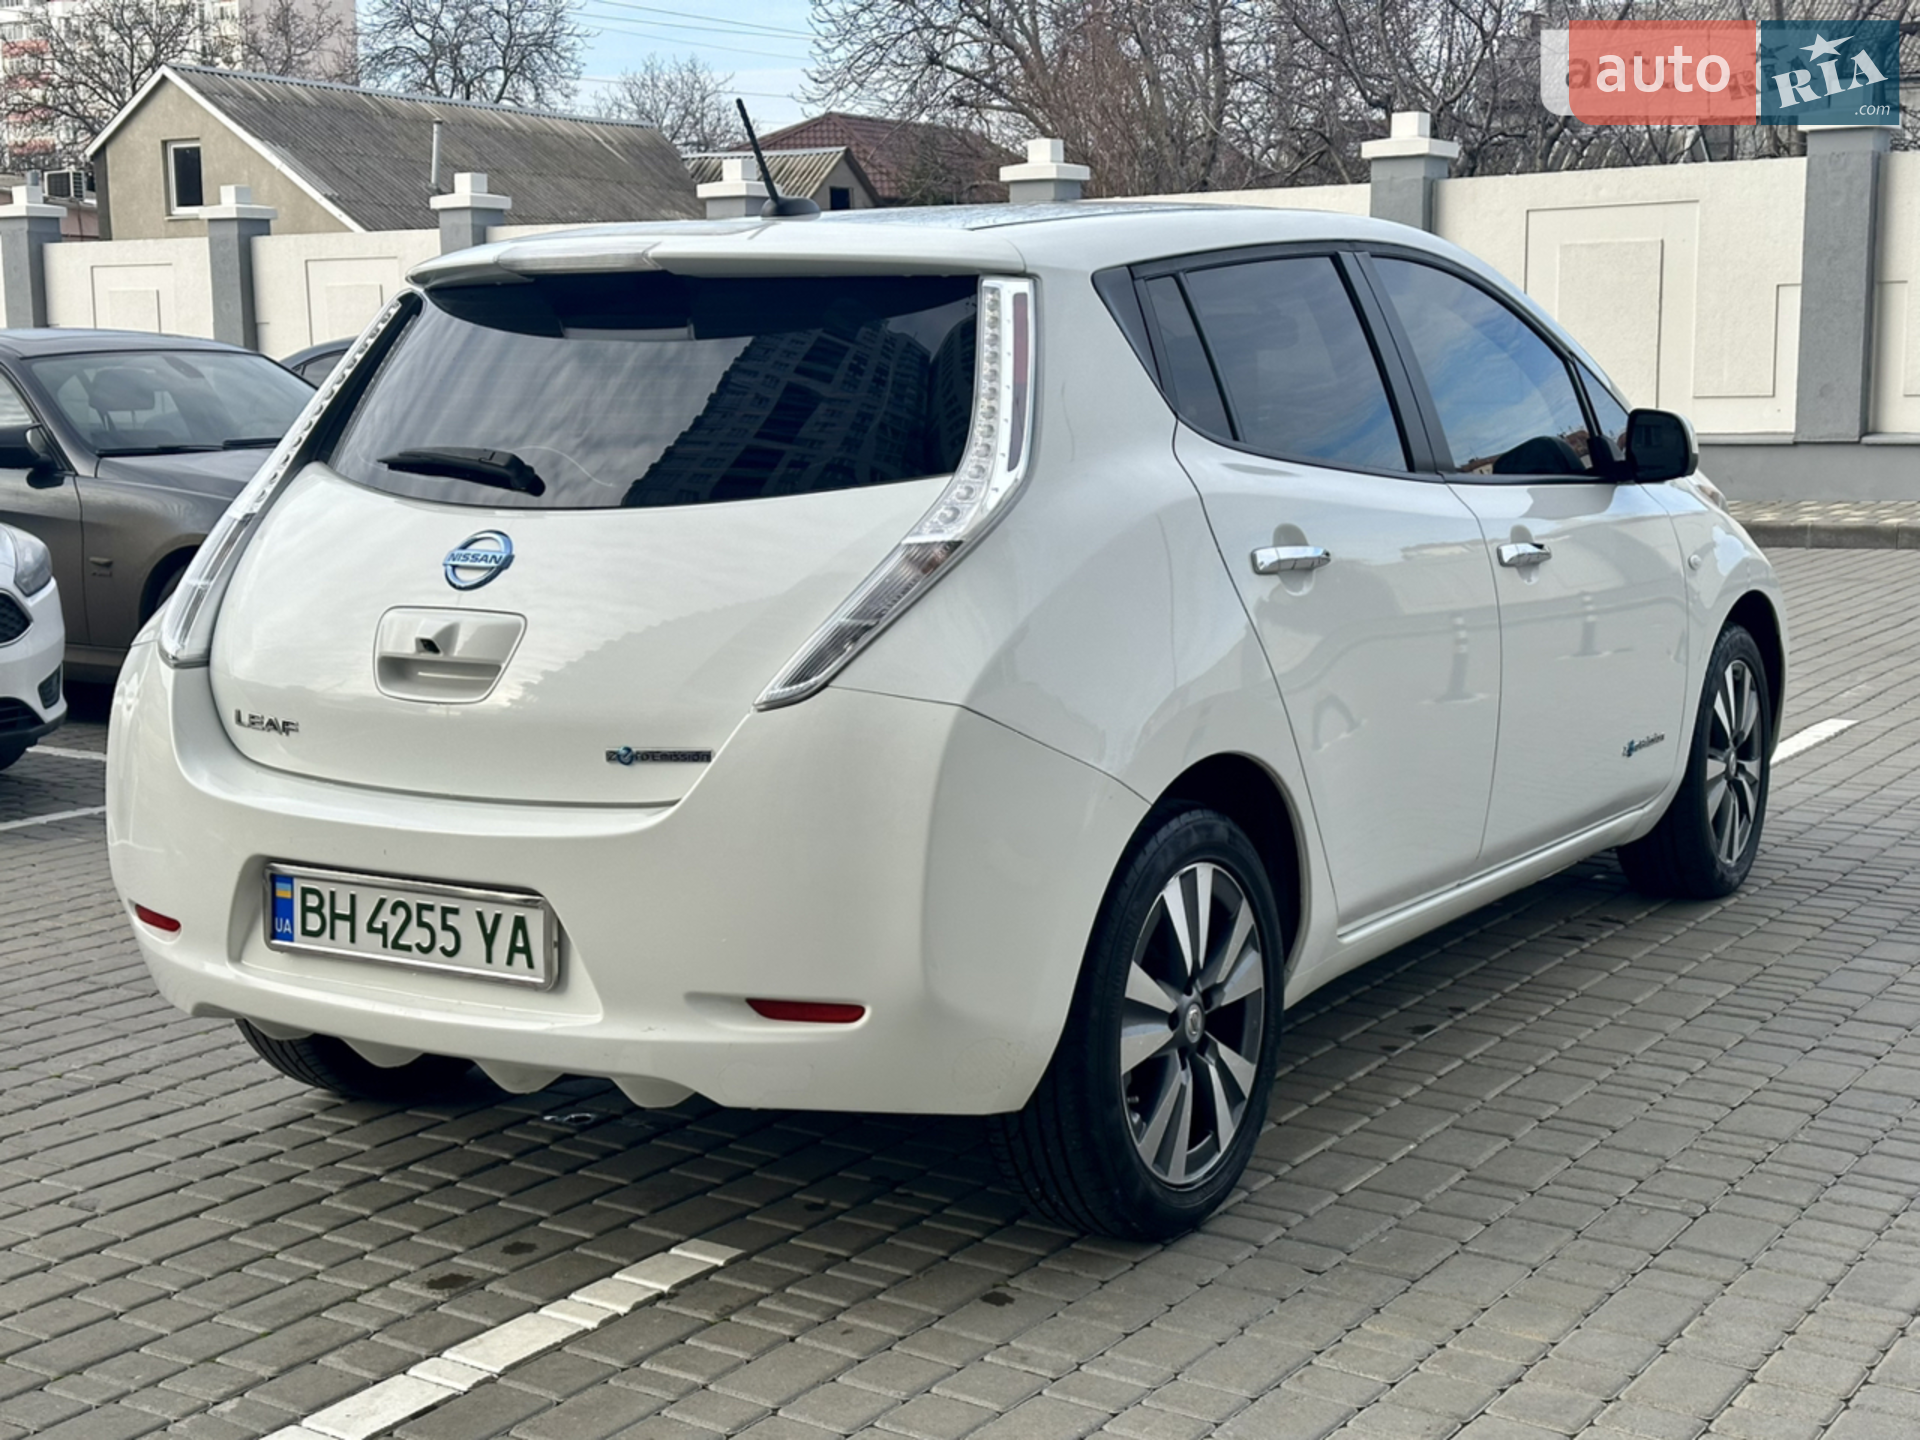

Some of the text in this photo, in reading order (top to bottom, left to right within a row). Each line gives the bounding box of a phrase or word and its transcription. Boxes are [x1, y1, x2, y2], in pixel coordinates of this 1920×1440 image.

[448, 552, 502, 565] NISSAN
[235, 709, 299, 736] LEAF
[274, 918, 292, 934] UA
[300, 886, 535, 969] BH 4255 YA
